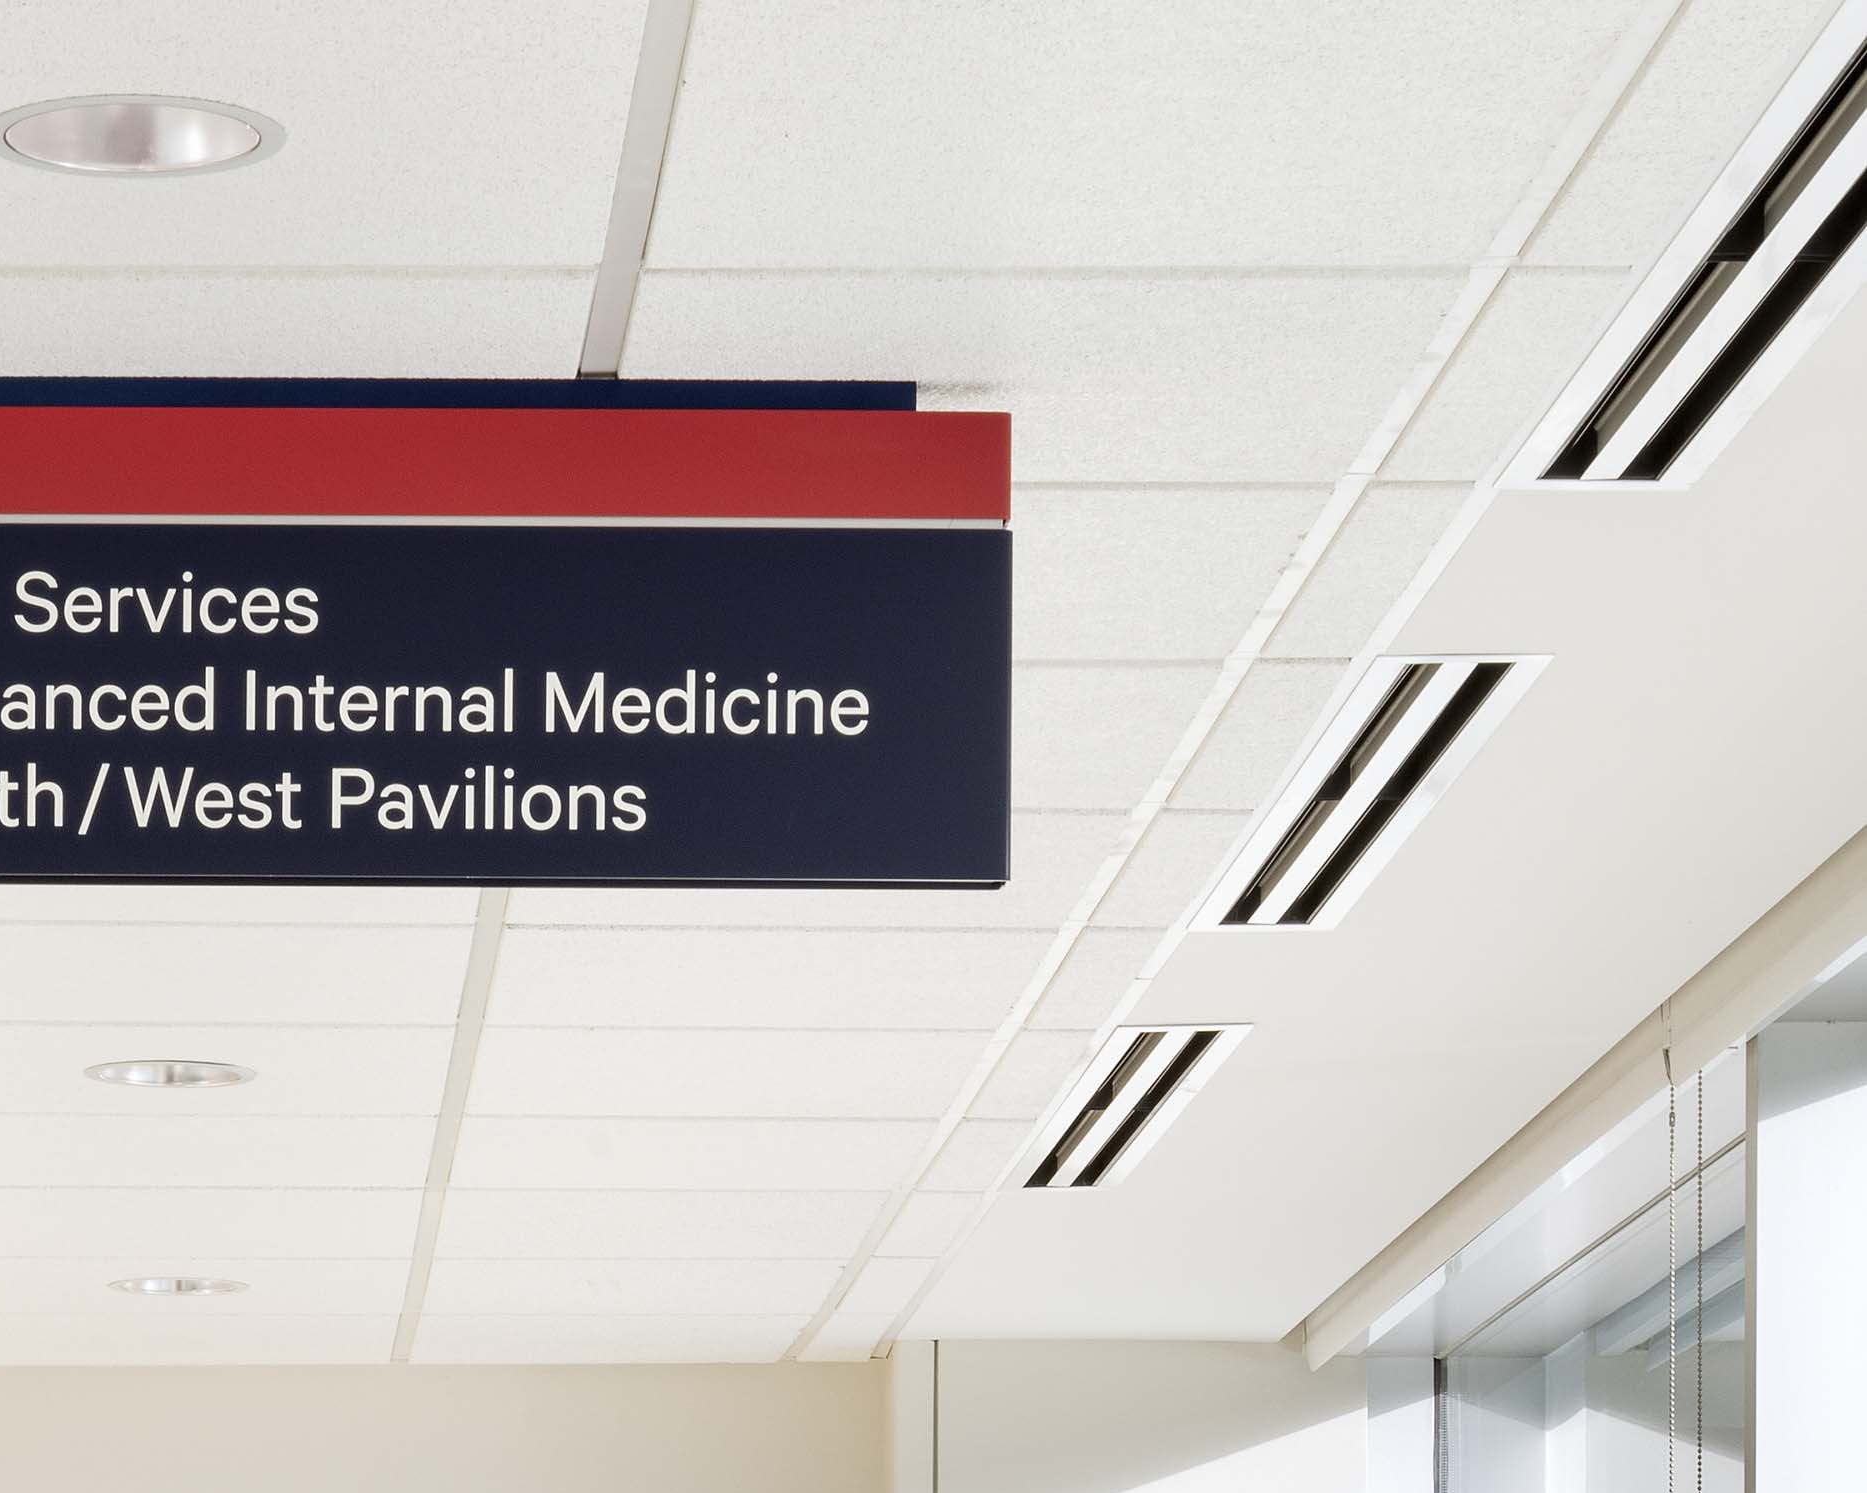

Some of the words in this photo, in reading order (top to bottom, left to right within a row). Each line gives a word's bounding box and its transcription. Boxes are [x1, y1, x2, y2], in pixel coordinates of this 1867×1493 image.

[14, 570, 319, 635] Services
[245, 667, 514, 733] Internal
[545, 669, 870, 736] Medicine
[331, 765, 647, 832] Pavilions
